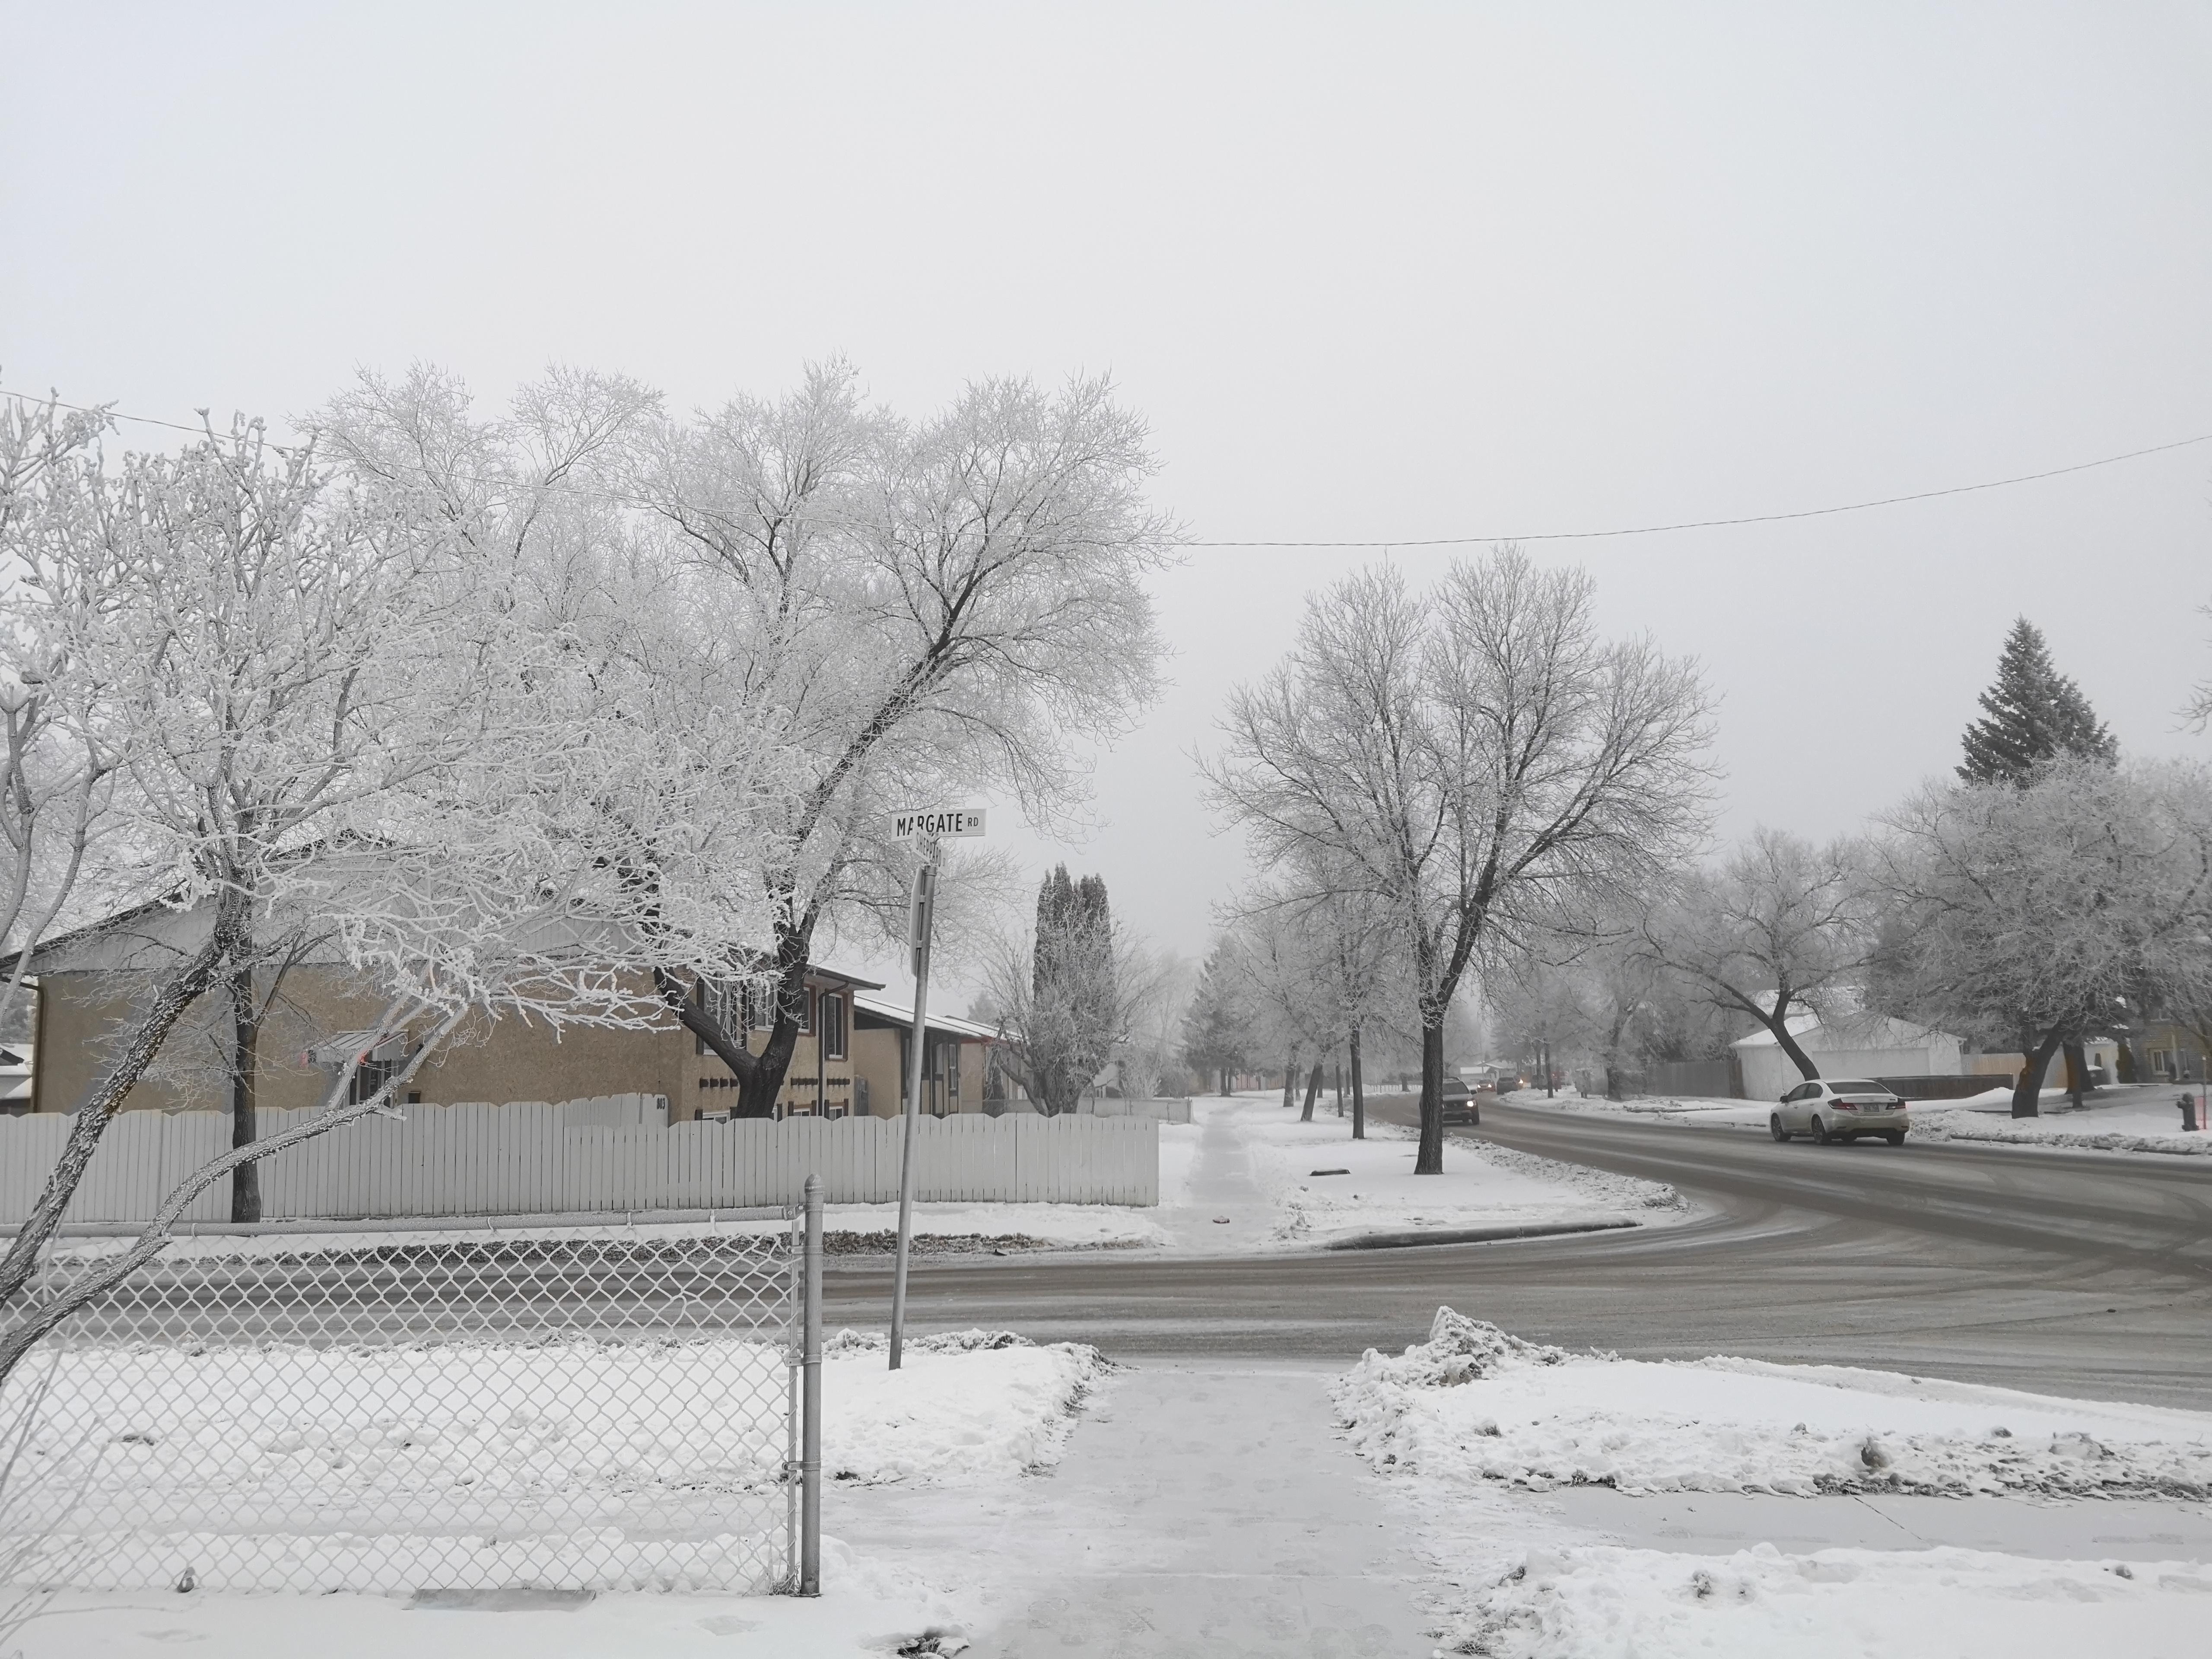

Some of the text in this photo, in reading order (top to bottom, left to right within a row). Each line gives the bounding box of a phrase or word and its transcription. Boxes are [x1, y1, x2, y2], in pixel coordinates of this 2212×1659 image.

[897, 813, 979, 837] MARGATE RD
[916, 832, 942, 868] SHEPPARD
